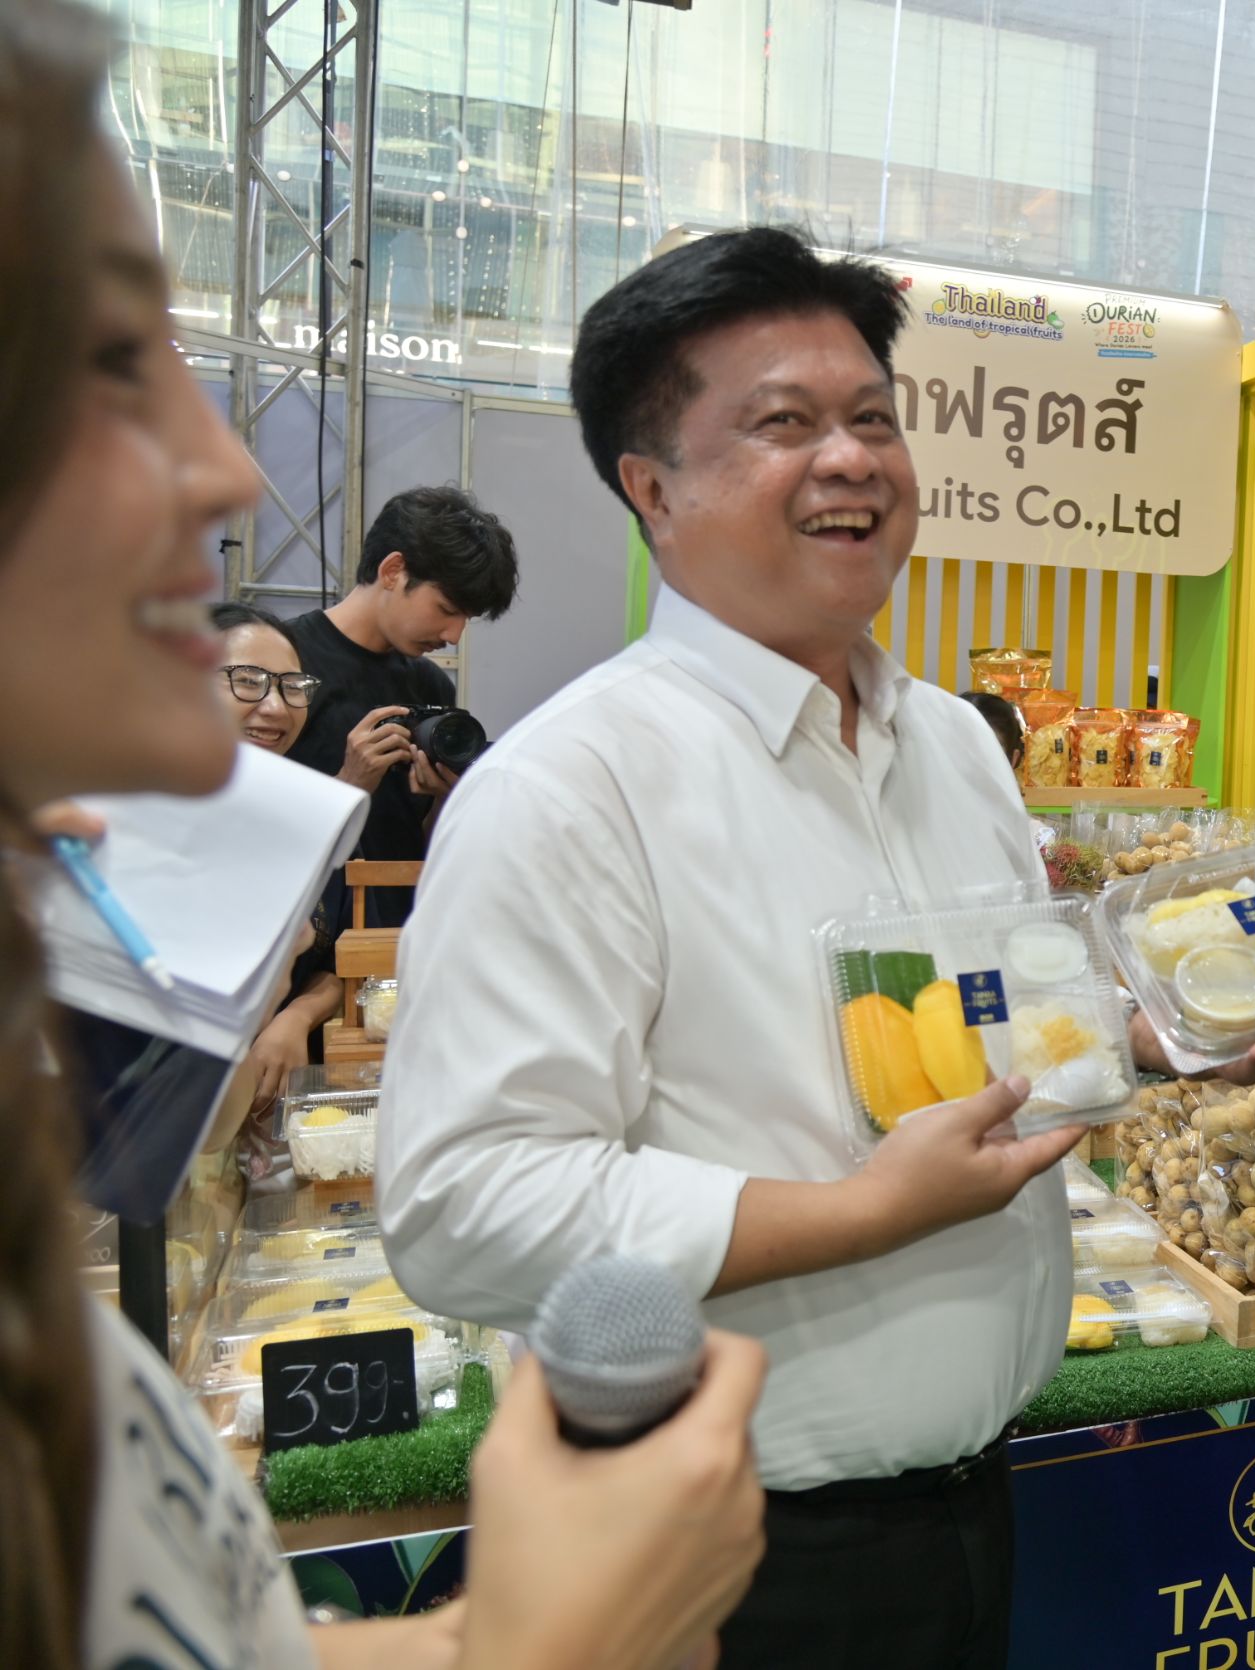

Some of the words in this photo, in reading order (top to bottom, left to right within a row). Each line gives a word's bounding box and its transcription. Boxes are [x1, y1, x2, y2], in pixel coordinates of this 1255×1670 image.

[943, 283, 1047, 324] Thailand
[925, 312, 945, 325] The
[948, 314, 972, 327] land
[974, 318, 987, 329] of
[989, 320, 1030, 335] tropical
[1031, 326, 1063, 339] fruits
[1108, 320, 1142, 336] FEST
